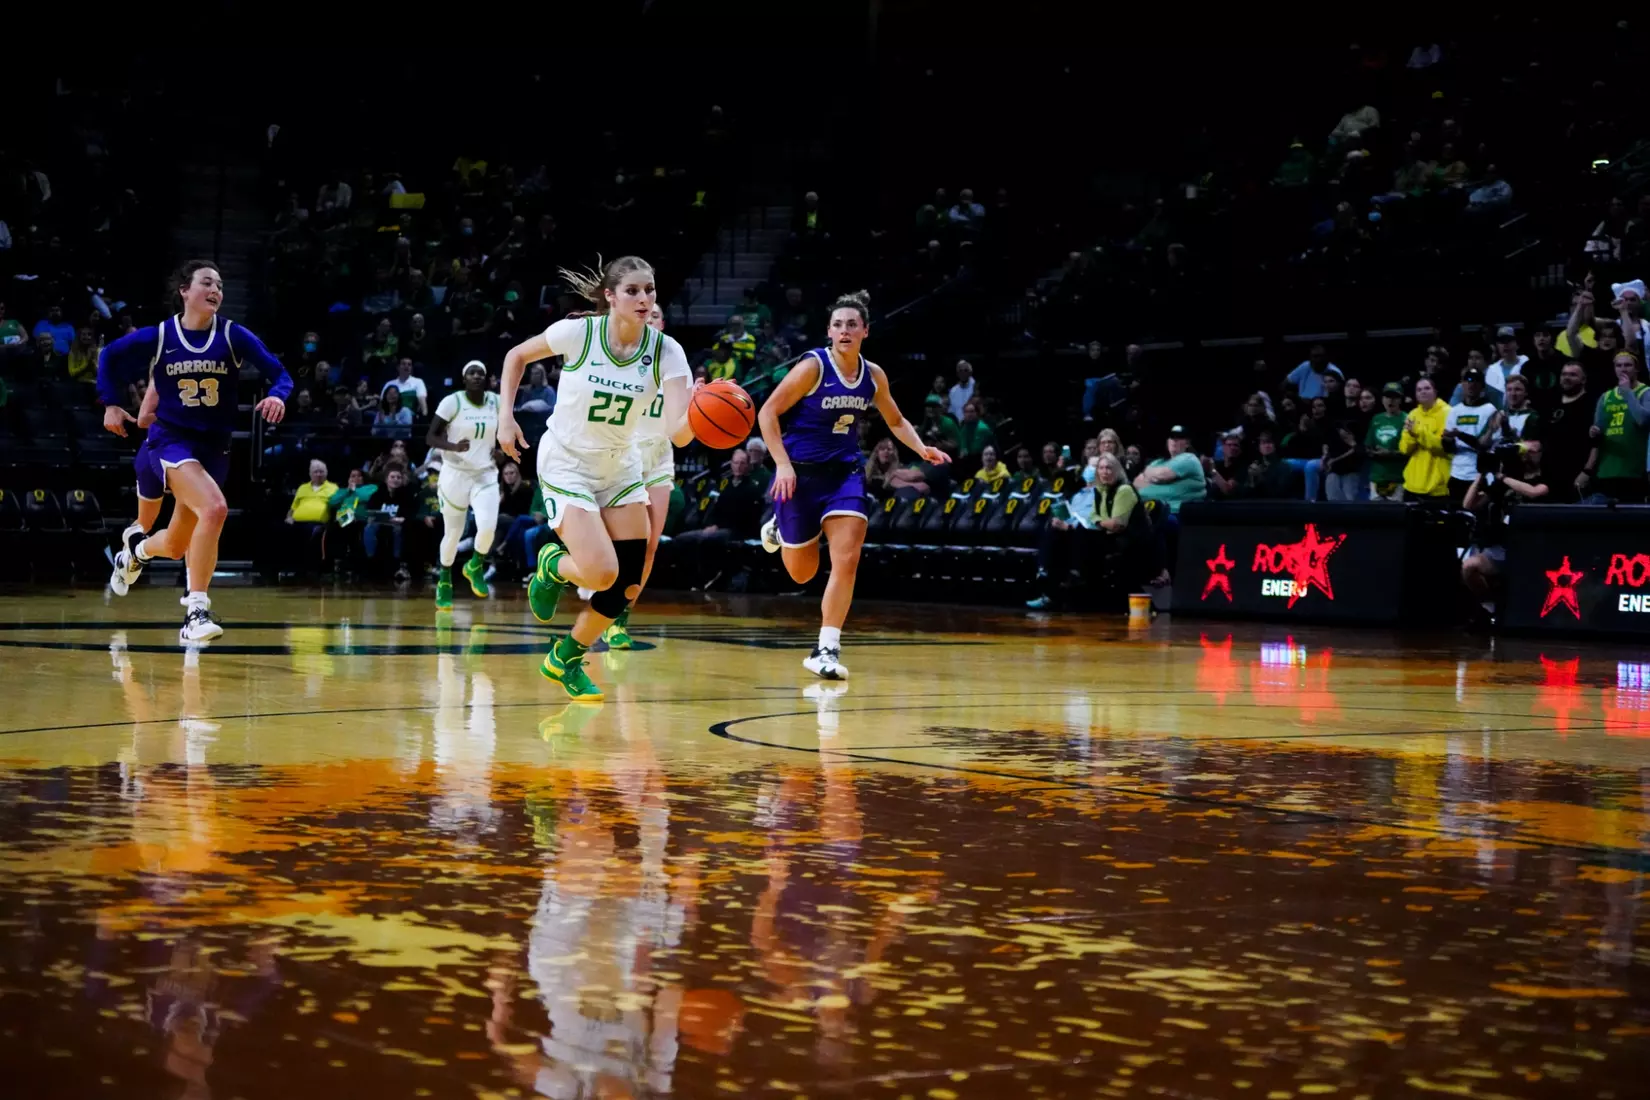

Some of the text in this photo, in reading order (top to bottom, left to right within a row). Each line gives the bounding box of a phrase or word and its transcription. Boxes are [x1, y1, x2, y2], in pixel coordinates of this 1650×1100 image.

[166, 360, 228, 376] CARROLL
[178, 378, 219, 407] 23
[588, 374, 645, 393] DUCKS
[587, 390, 634, 426] 23
[641, 393, 664, 418] 0
[474, 422, 486, 439] 11
[832, 414, 855, 435] 2
